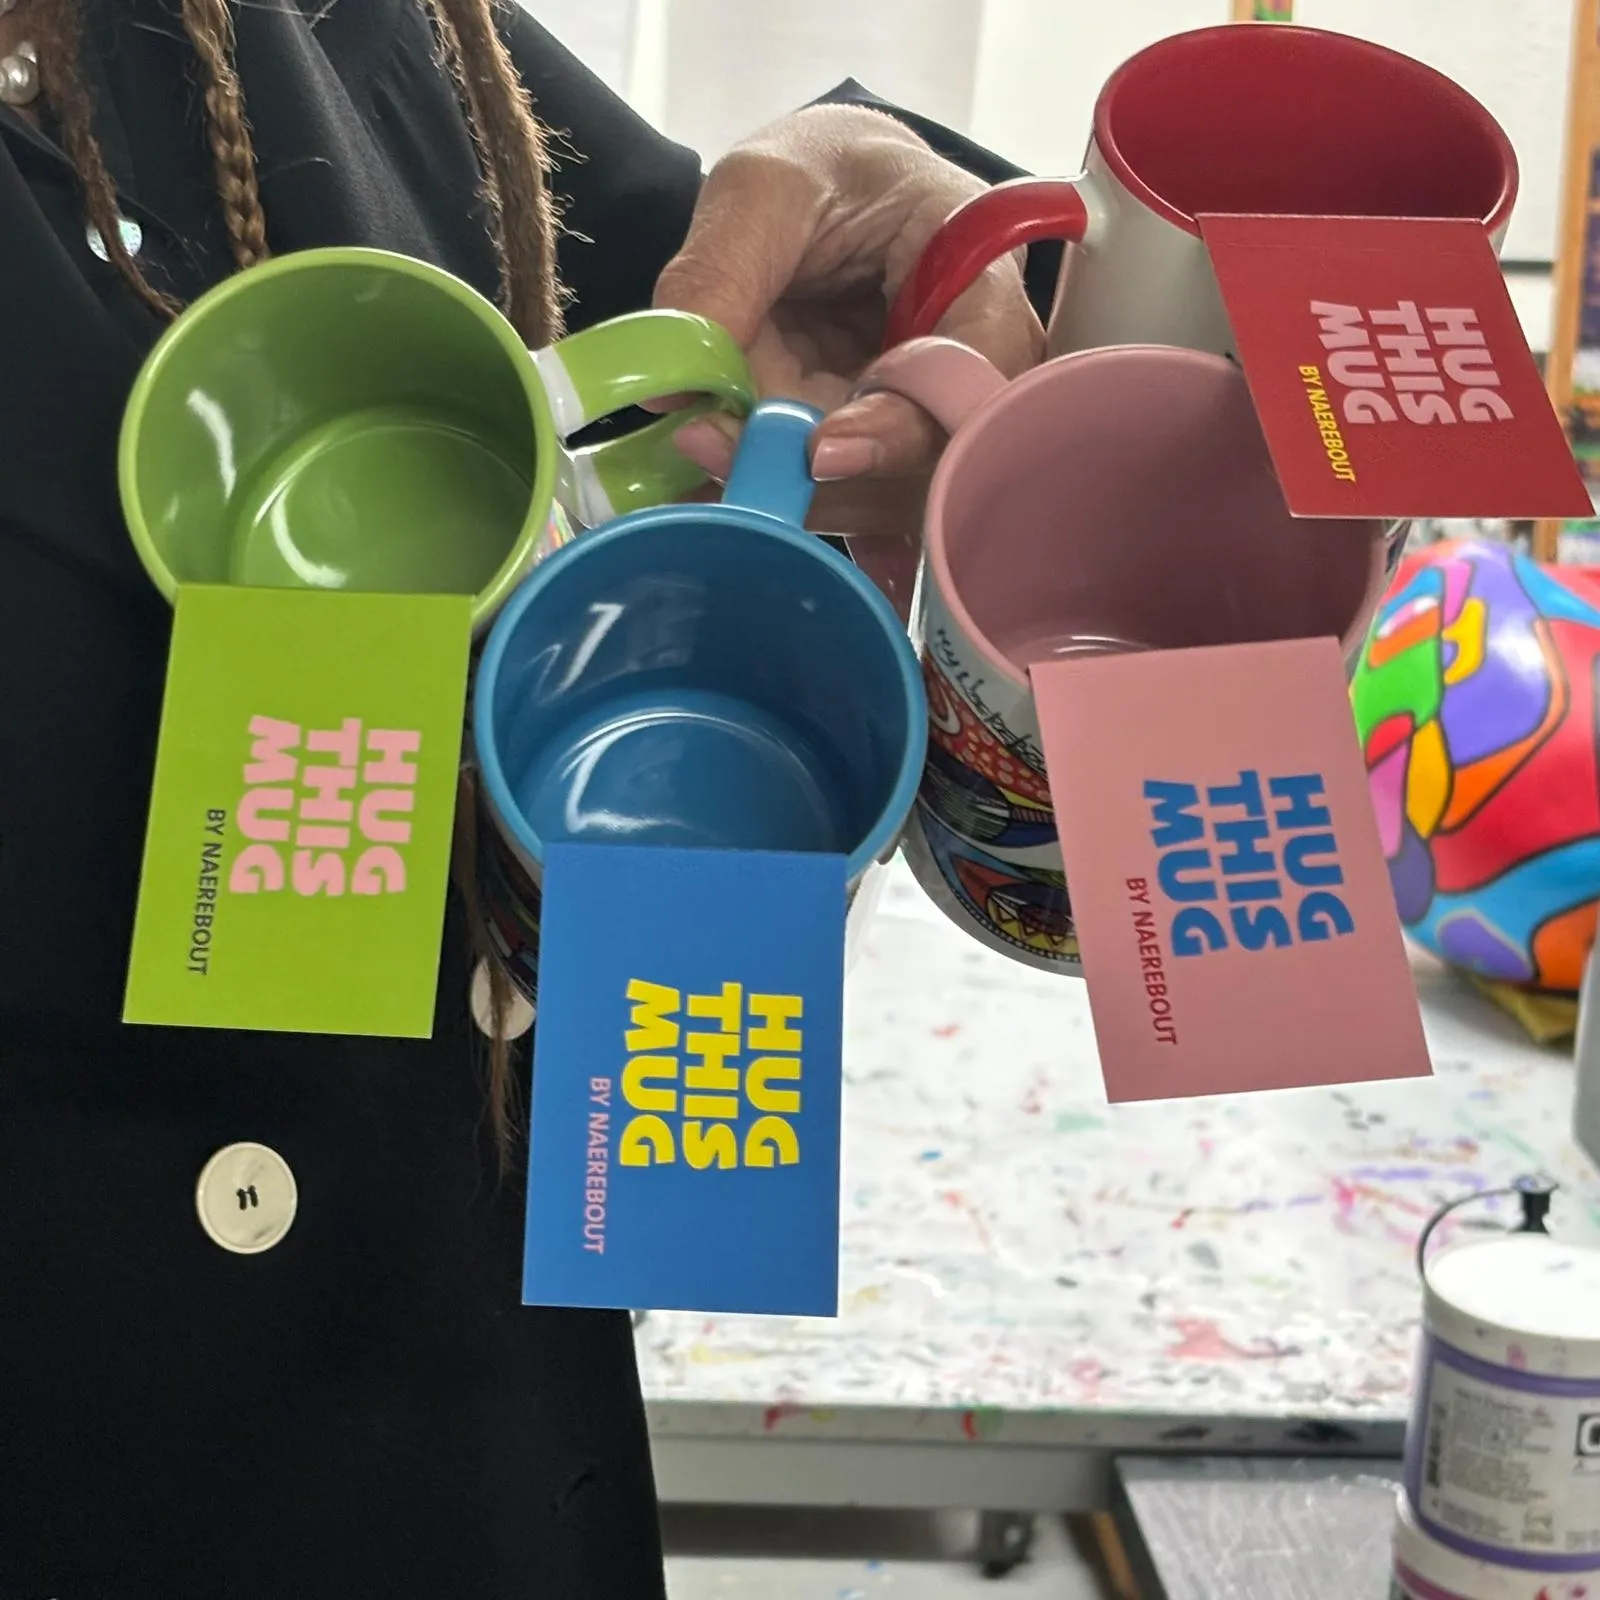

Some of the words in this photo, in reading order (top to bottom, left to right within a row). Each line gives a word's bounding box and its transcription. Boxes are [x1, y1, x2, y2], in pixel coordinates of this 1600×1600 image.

[1298, 365, 1323, 387] BY
[1311, 301, 1397, 423] MUG
[1368, 301, 1456, 424] THIS
[1425, 308, 1513, 421] HUG
[1306, 389, 1357, 482] NAEREBOUT
[205, 809, 226, 836] BY
[230, 716, 300, 892] MUG
[293, 719, 361, 895] THIS
[352, 730, 420, 894] HUG
[1144, 781, 1228, 956] MUG
[1207, 771, 1292, 950] THIS
[1269, 774, 1354, 941] HUG
[187, 843, 222, 976] NAEREBOUT
[1126, 878, 1150, 904] BY
[1133, 911, 1177, 1045] NAEREBOUT
[590, 1077, 611, 1107] BY
[619, 978, 681, 1168] MUG
[681, 981, 743, 1170] THIS
[743, 993, 804, 1168] HUG
[583, 1112, 608, 1255] NAEREBOUT
